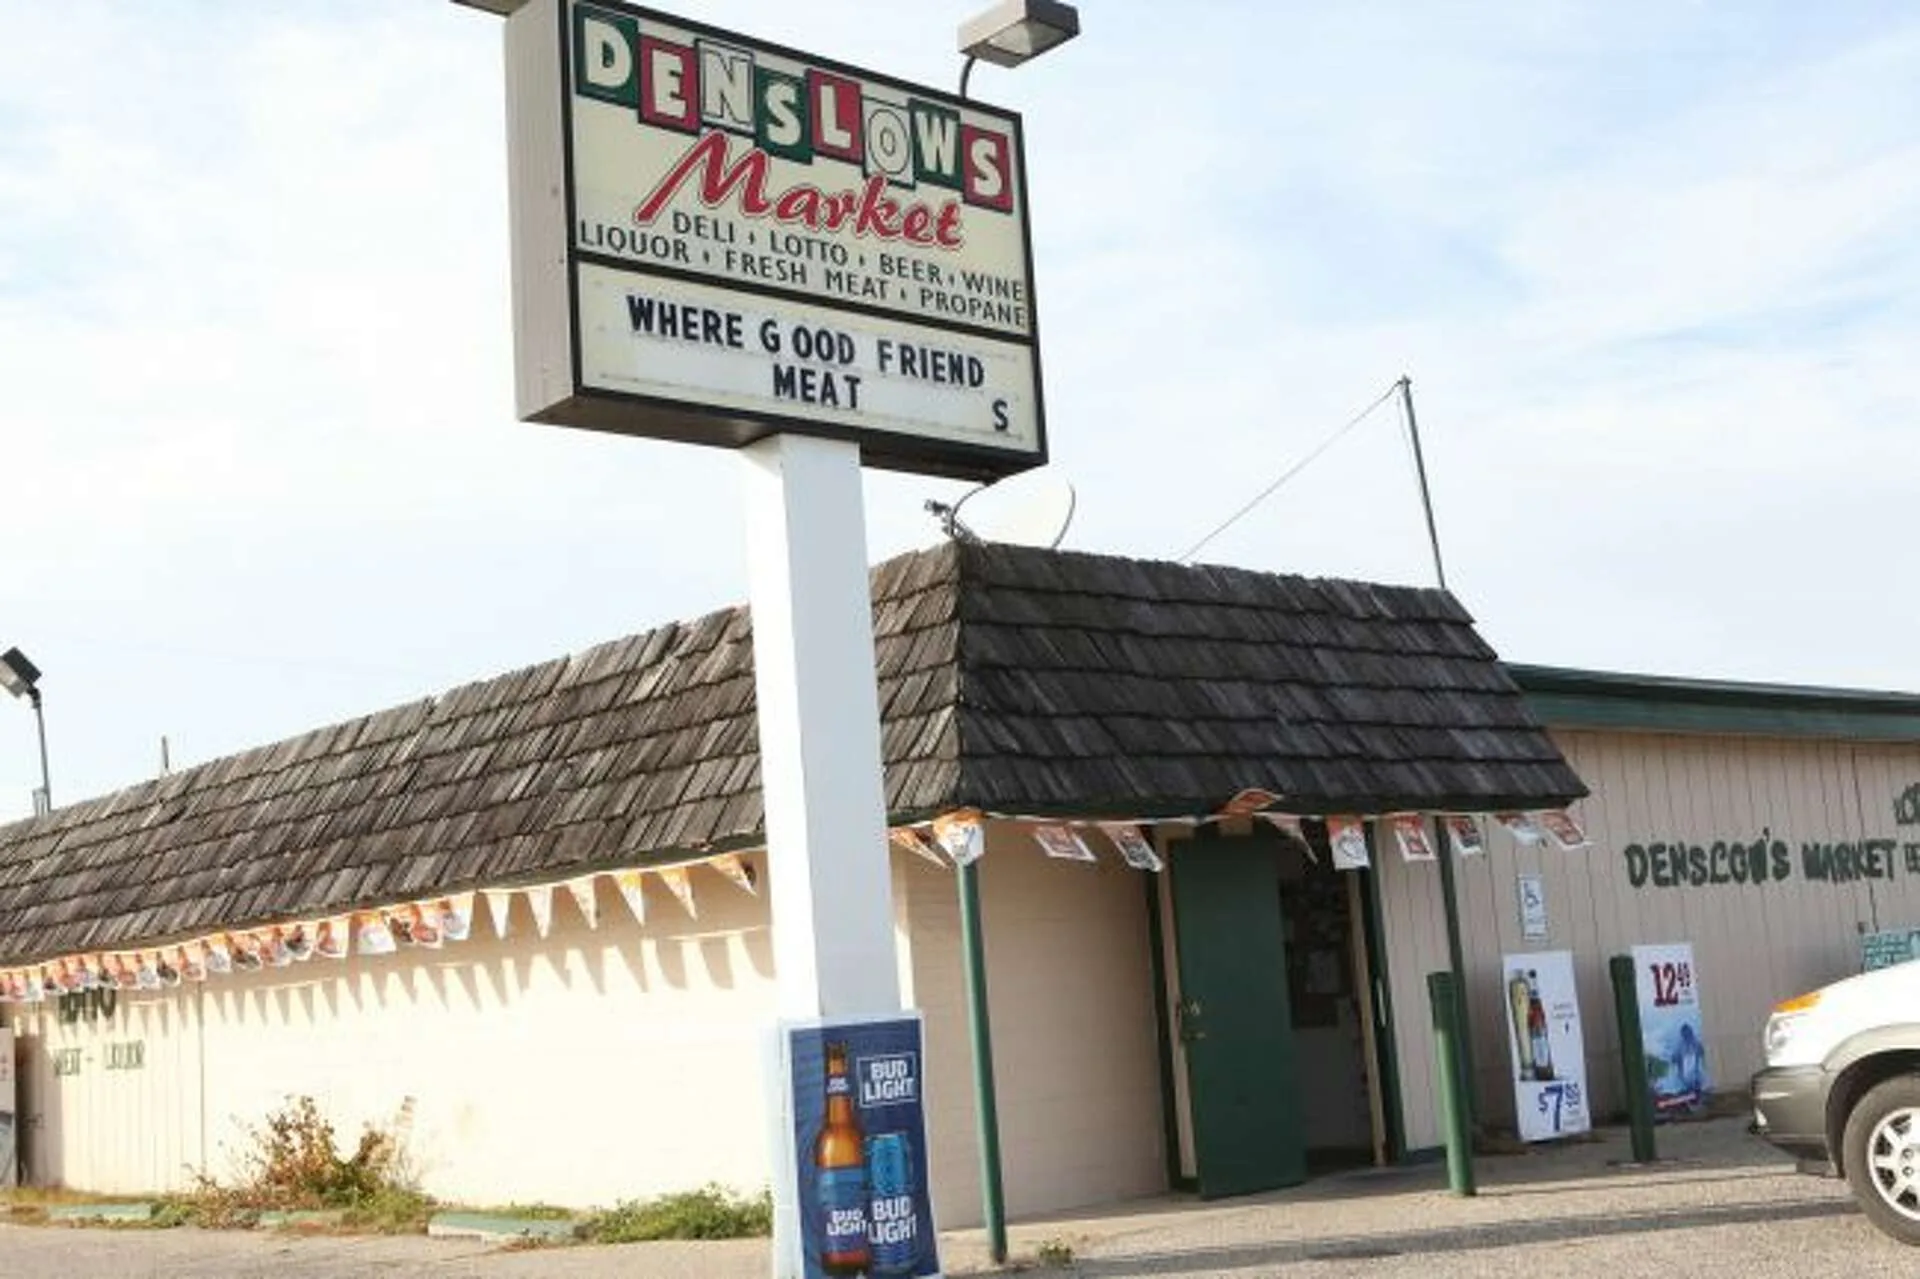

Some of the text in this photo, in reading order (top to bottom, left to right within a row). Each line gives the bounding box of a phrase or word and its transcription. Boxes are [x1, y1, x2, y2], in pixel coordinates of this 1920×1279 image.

[581, 16, 1004, 200] DENSLOWS
[634, 128, 965, 249] Market
[579, 219, 1027, 328] LIQUOR FRESH MEAT PROPANE
[672, 210, 1026, 302] DELI LOTTO BEER WINE
[626, 294, 745, 350] WHERE
[876, 341, 986, 389] FRIEND
[772, 363, 1010, 433] MEAT S
[1801, 837, 1898, 885] MARKET
[864, 1078, 915, 1101] LIGHT
[870, 1058, 909, 1081] BUD
[868, 1213, 918, 1245] LIGHT
[872, 1195, 912, 1221] BUD
